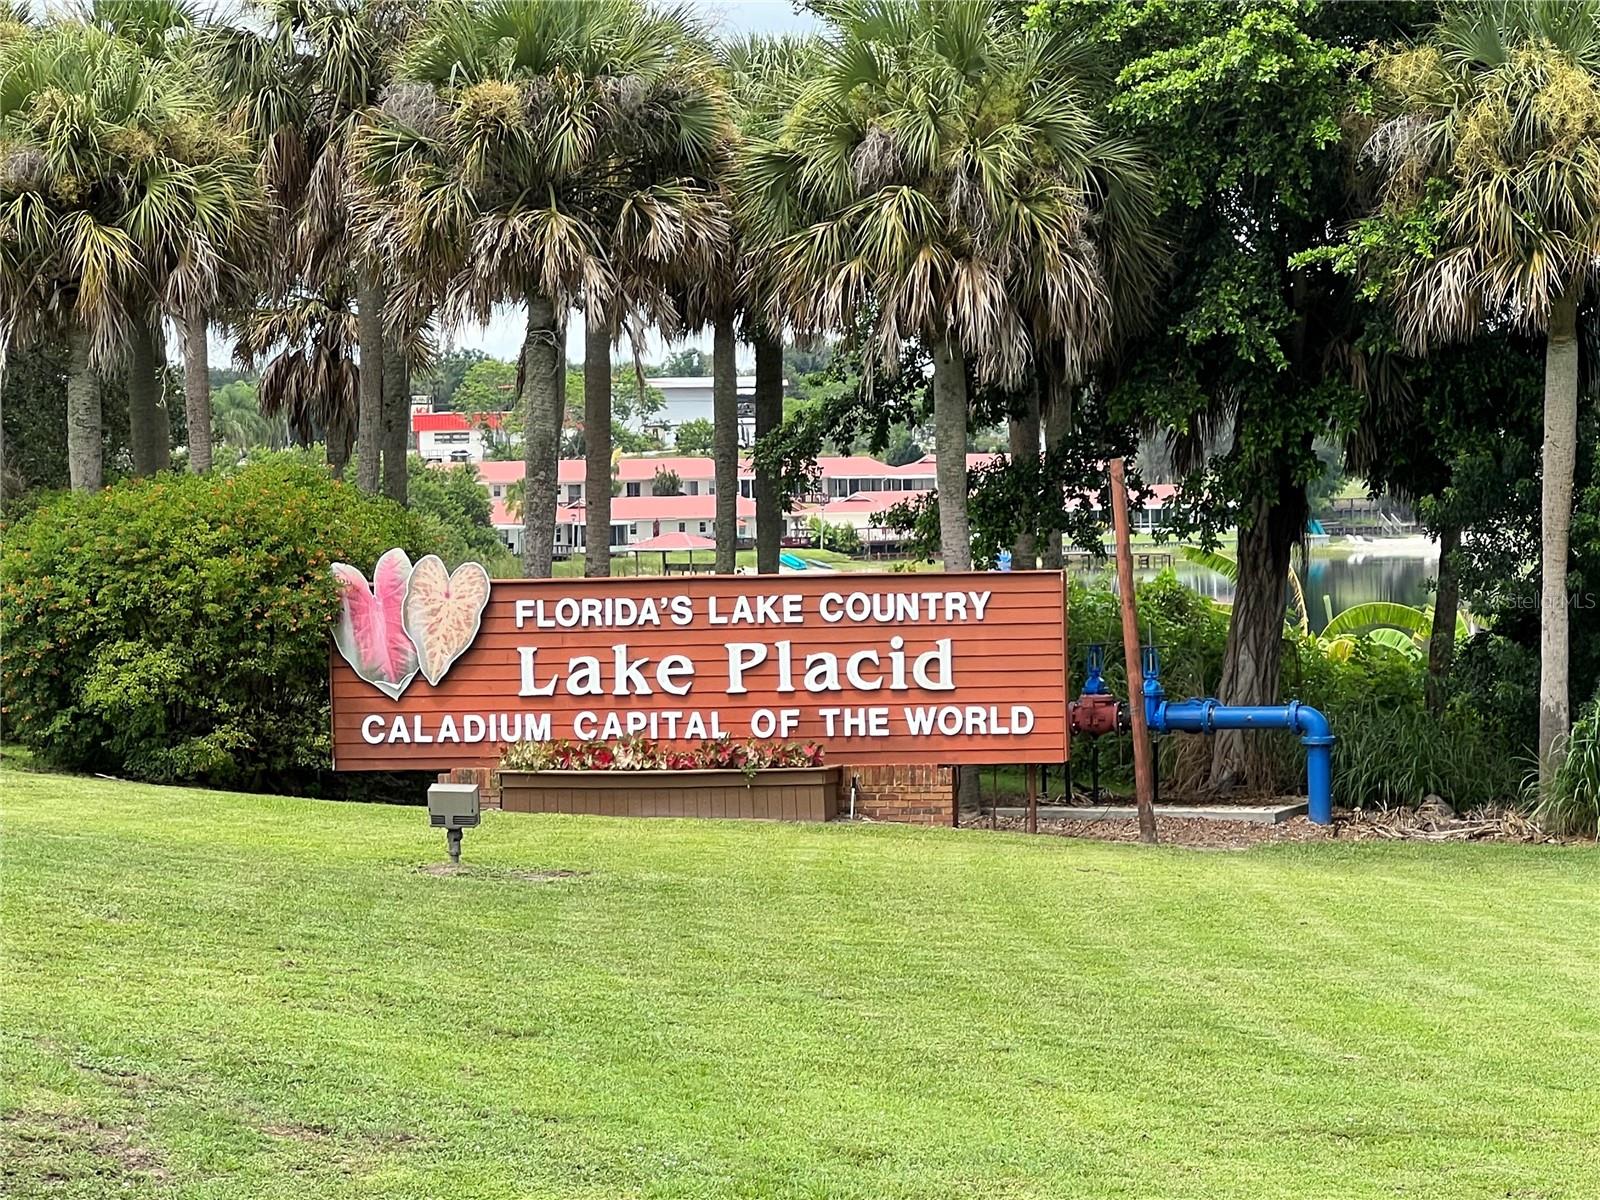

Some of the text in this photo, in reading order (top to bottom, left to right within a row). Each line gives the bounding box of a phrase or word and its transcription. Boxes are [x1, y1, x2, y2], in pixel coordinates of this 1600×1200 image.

[515, 590, 991, 627] FLORIDA'S LAKE COUNTRY
[517, 636, 955, 696] Lake Placid
[362, 704, 1034, 744] CALADIUM CAPITAL OF THE WORLD
